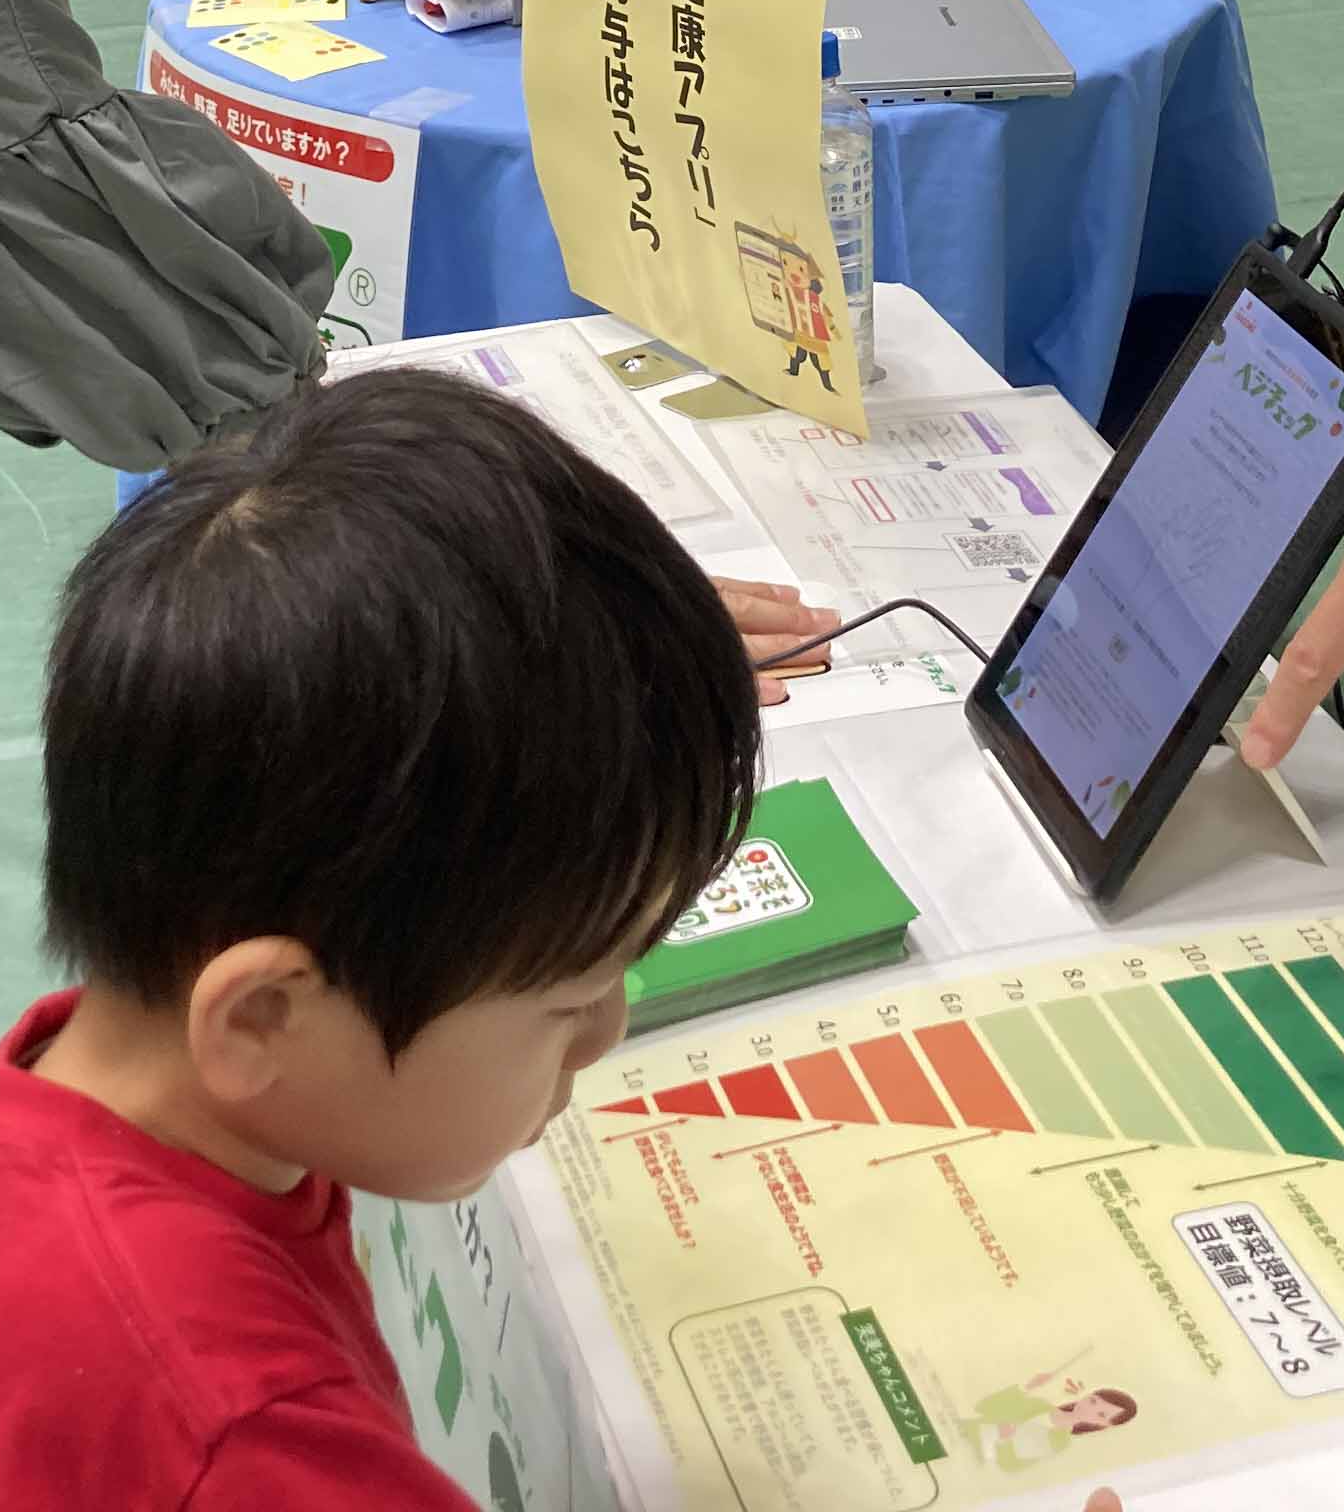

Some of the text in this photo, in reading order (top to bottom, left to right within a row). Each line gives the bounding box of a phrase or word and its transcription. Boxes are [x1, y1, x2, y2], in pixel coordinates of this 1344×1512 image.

[1233, 363, 1321, 441] ベジチェック
[1237, 932, 1271, 963] 11.0
[1296, 924, 1330, 956] 12.0
[1122, 956, 1148, 980] 9.0
[1178, 942, 1211, 974] 10.0
[1000, 978, 1025, 1002] 7.0
[1061, 966, 1087, 991] 8.0
[876, 1003, 901, 1028] 5.0
[939, 991, 964, 1015] 6.0
[815, 1018, 838, 1043] 4.0
[750, 1032, 774, 1058] 3.0
[685, 1049, 711, 1075] 2.0
[622, 1066, 645, 1090] 1.0
[1223, 1213, 1343, 1357] 野菜摂取レベル
